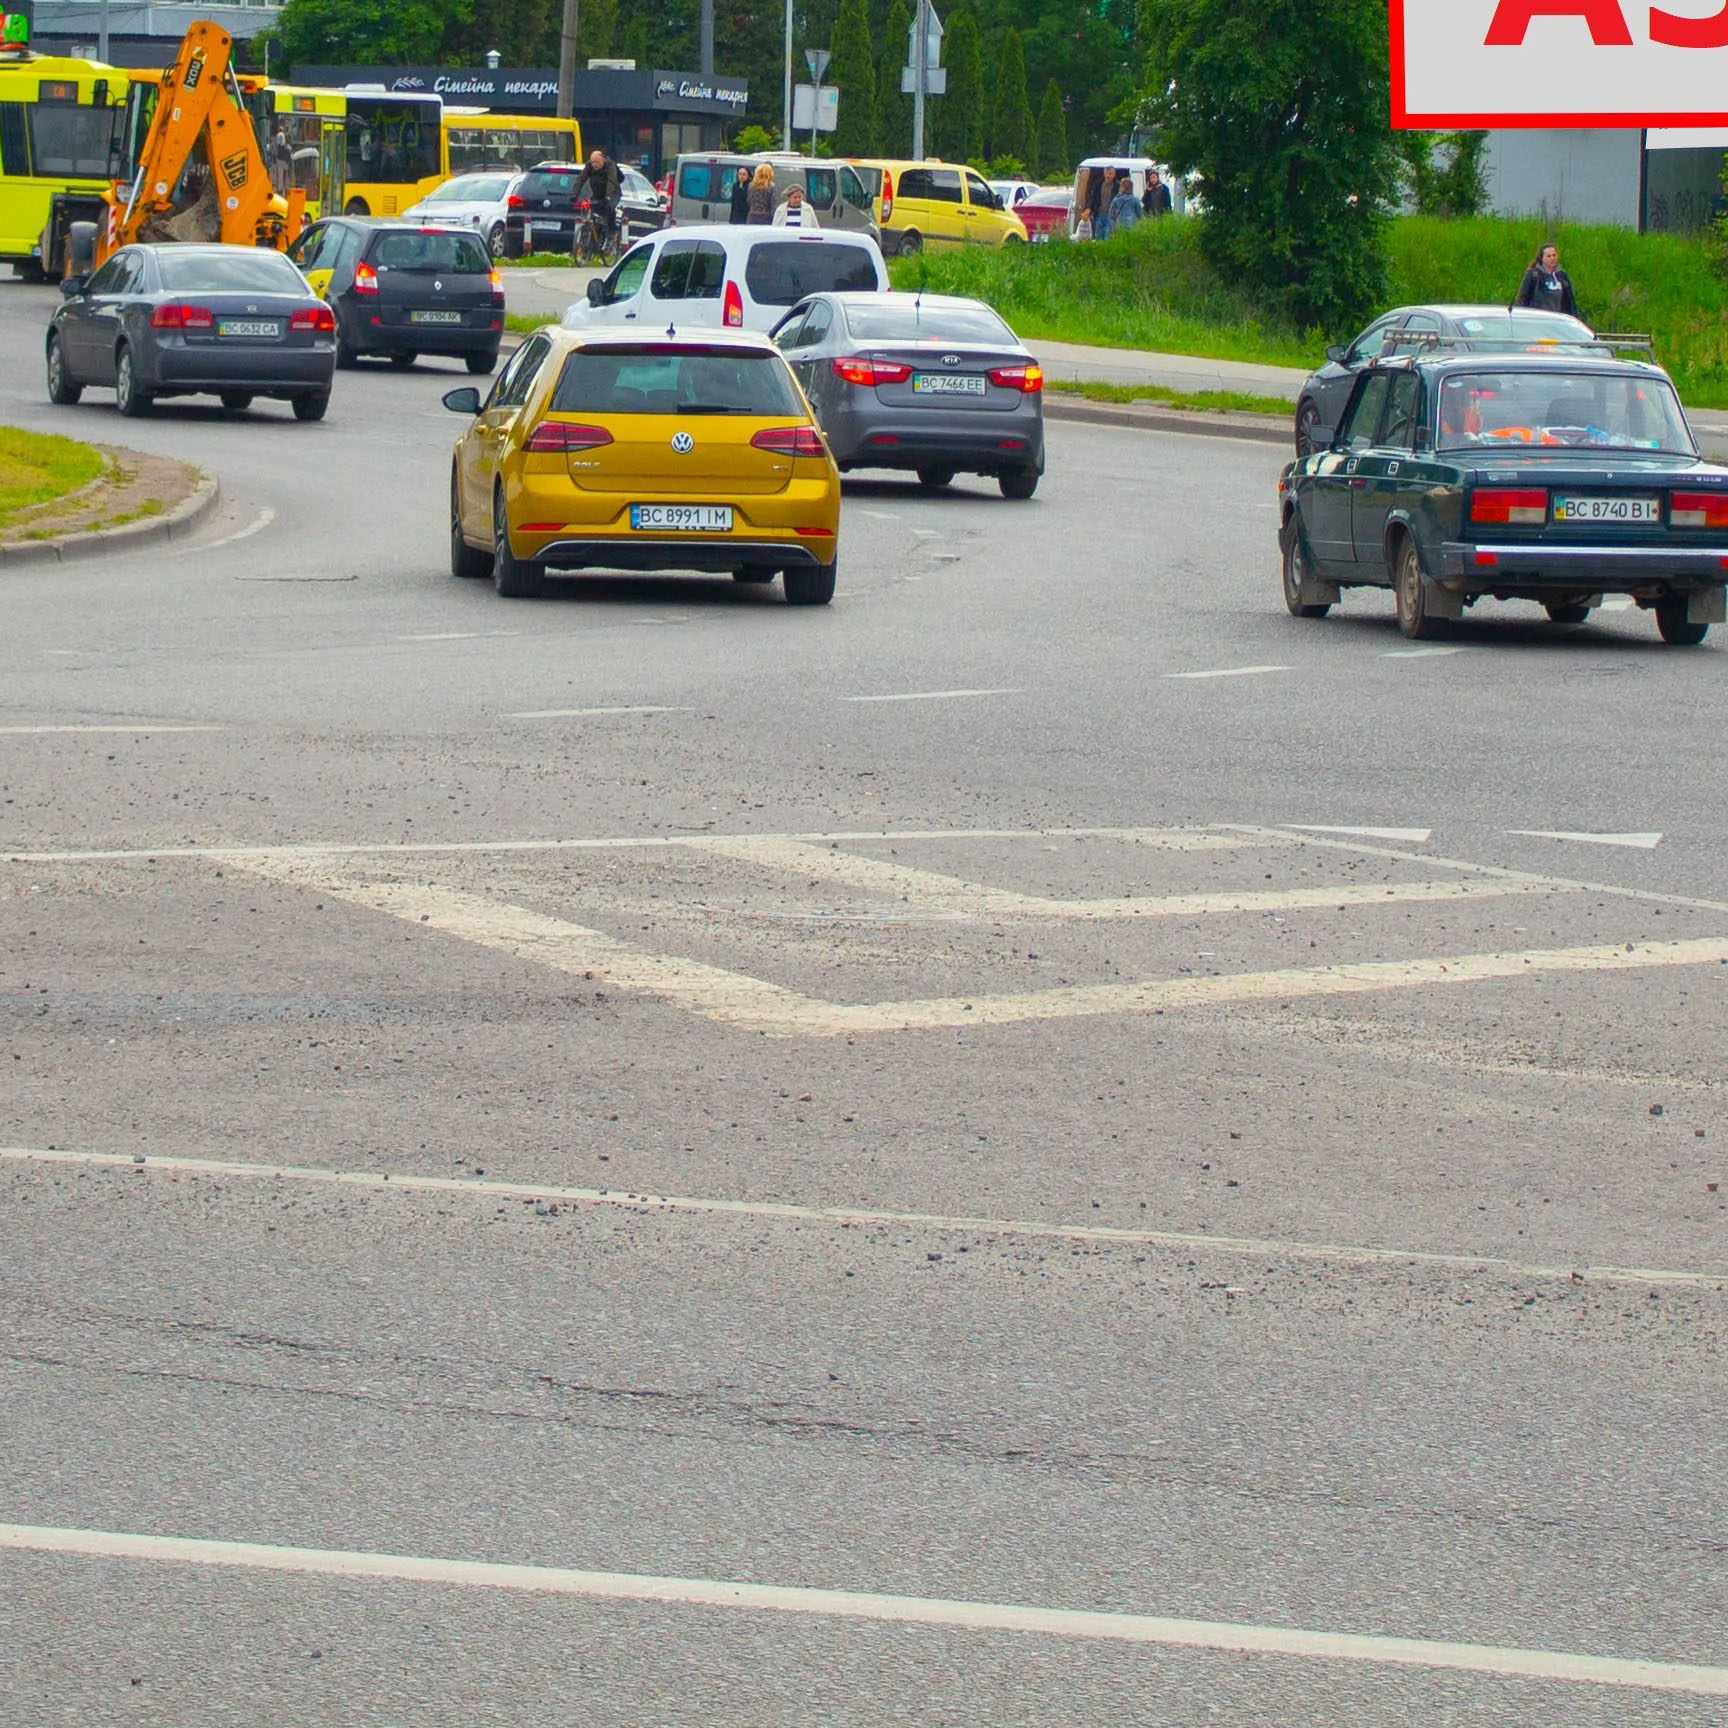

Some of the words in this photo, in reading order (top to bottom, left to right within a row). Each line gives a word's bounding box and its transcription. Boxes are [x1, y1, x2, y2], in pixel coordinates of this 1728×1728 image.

[433, 75, 495, 94] Сімейна
[504, 80, 560, 100] пекарн
[224, 155, 246, 187] JCB
[921, 377, 938, 388] BC
[940, 378, 965, 389] 7466
[967, 379, 983, 390] EE
[640, 508, 662, 523] BC
[666, 508, 701, 524] 8991
[707, 508, 726, 525] IM
[1565, 501, 1588, 517] BC
[1591, 501, 1628, 517] 8740
[1631, 502, 1651, 518] BI
